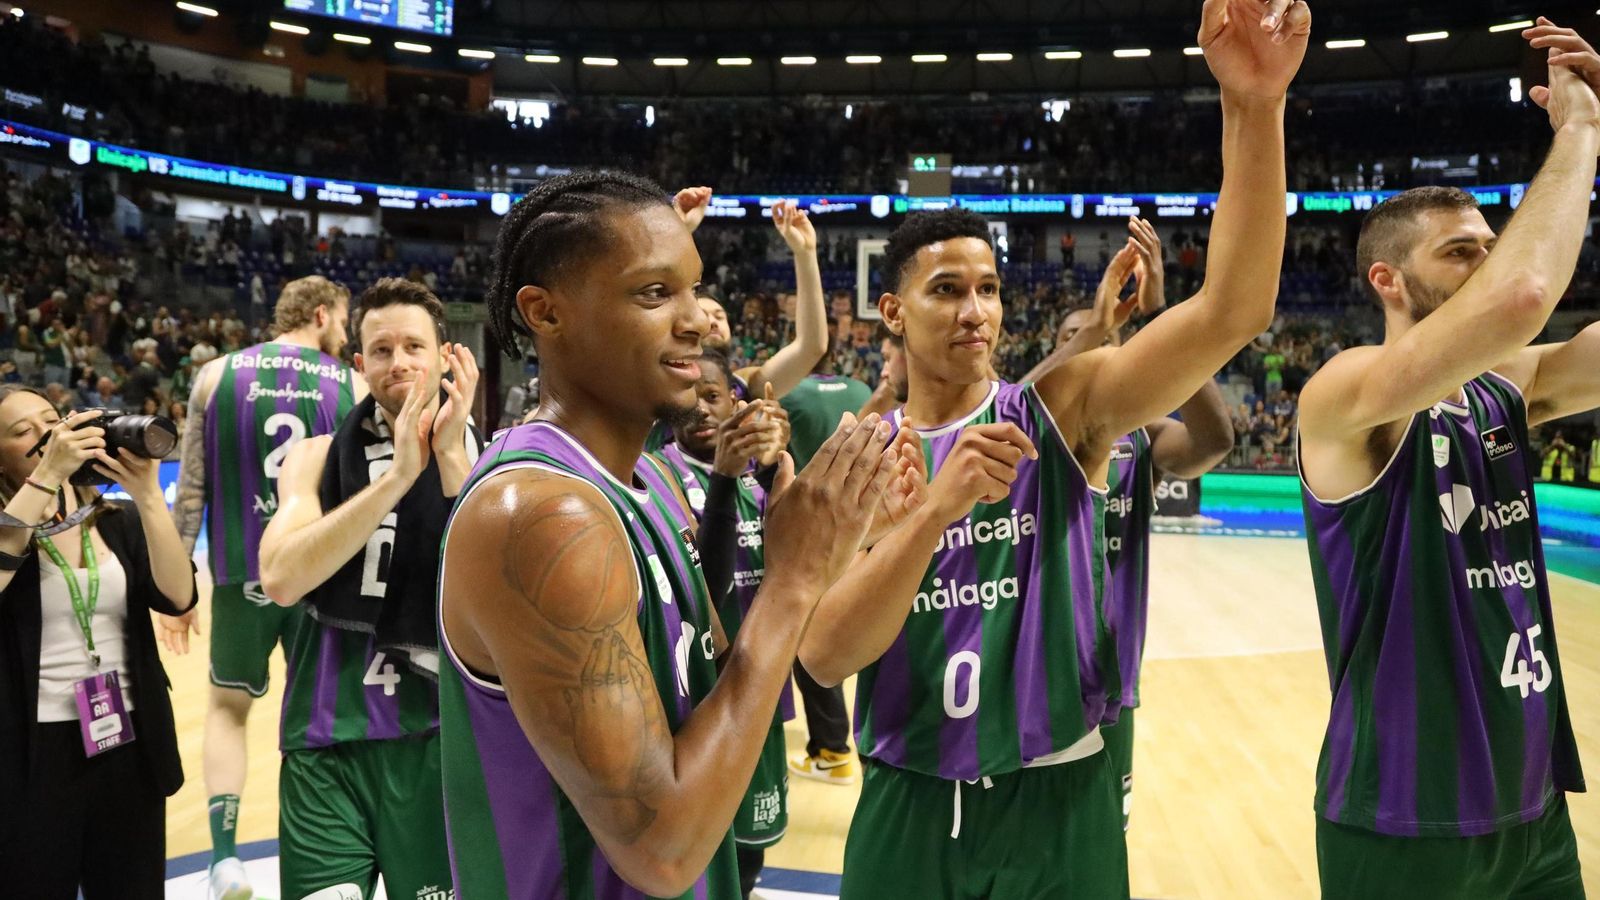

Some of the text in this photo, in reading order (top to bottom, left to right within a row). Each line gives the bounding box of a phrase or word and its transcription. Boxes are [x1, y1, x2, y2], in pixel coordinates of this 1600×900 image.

[97, 146, 147, 172] Unicaja
[149, 156, 169, 175] VS
[1011, 198, 1066, 212] Badalona
[1304, 195, 1351, 213] Unicaja
[1353, 195, 1373, 210] VS
[231, 354, 347, 383] Balcerowski
[264, 413, 307, 479] 2
[363, 651, 401, 696] 4
[1500, 623, 1553, 699] 45
[943, 650, 981, 719] 0
[97, 734, 121, 750] STAFF
